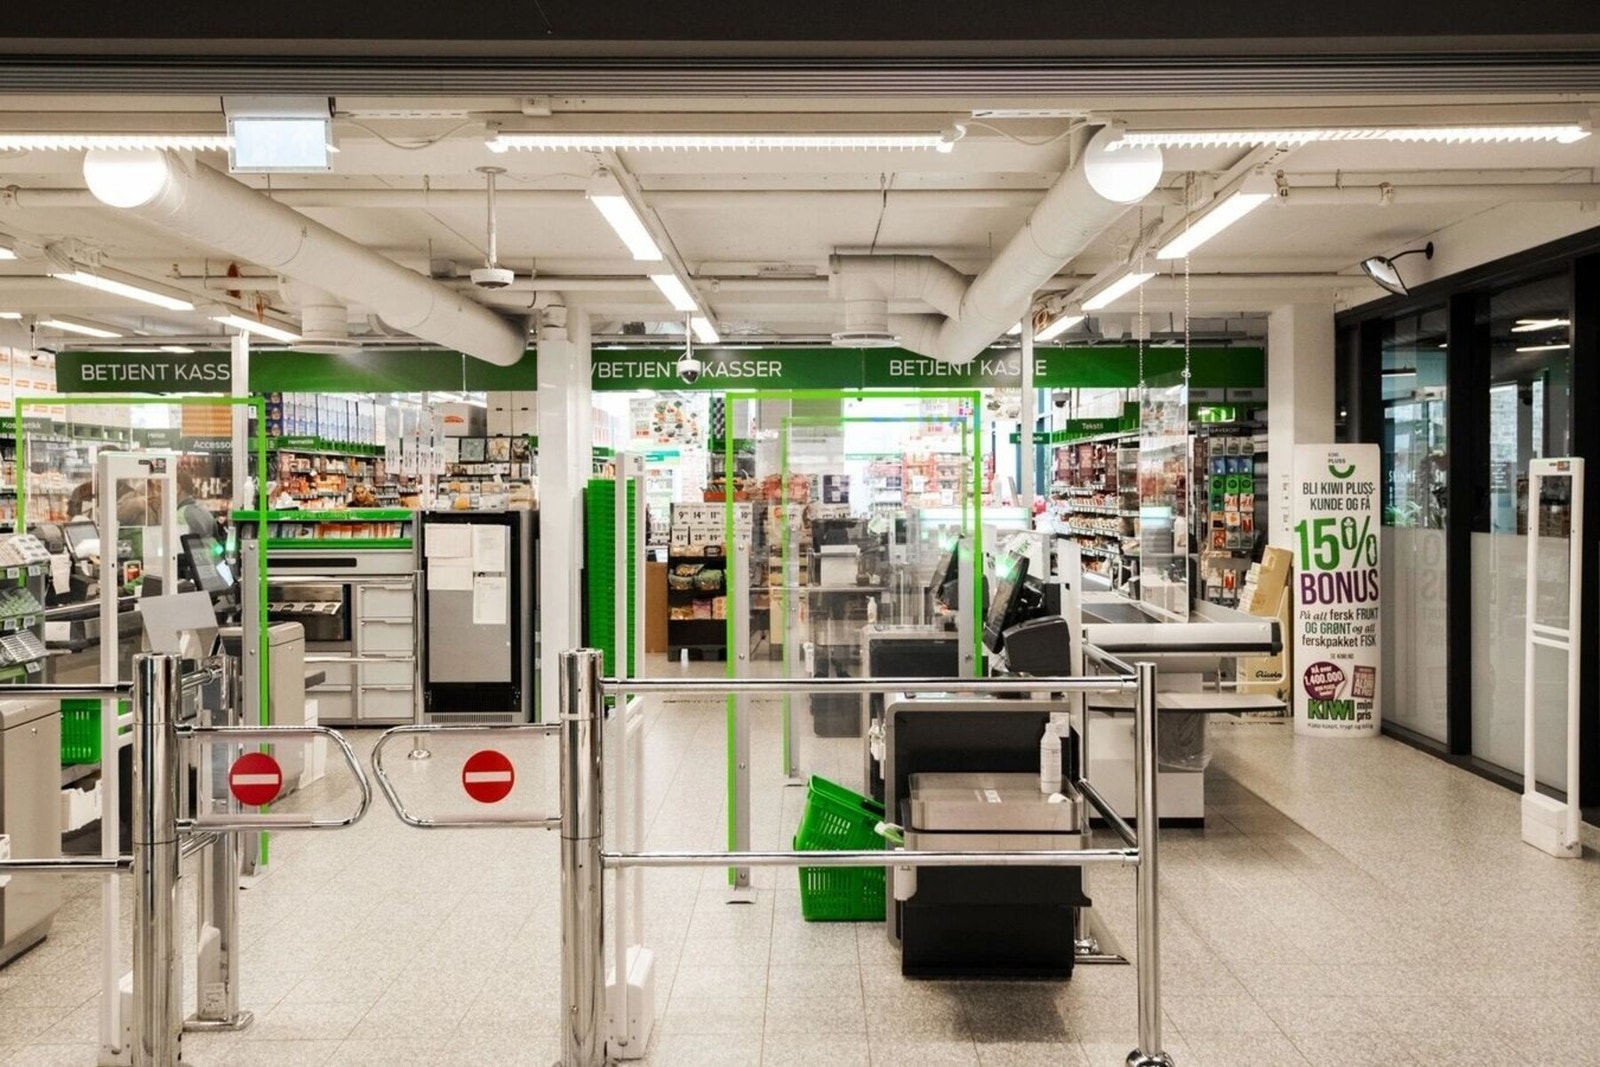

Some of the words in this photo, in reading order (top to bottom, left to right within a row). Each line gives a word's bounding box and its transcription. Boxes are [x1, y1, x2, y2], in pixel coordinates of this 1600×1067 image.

[81, 363, 169, 381] BETJENT
[175, 363, 231, 381] KASS
[701, 360, 782, 378] KASSER
[889, 359, 975, 376] BETJENT
[980, 359, 1047, 376] KASE
[193, 440, 233, 449] Accesso
[1303, 482, 1318, 495] BLI
[1320, 482, 1344, 495] KIWI
[1346, 482, 1376, 495] PLUSS-
[1310, 498, 1343, 511] KUNDE
[1346, 497, 1359, 511] OG
[1361, 494, 1371, 511] FÅ
[1294, 515, 1378, 571] 15%
[1300, 568, 1379, 605] BONUS
[1330, 608, 1354, 621] fersk
[1356, 607, 1379, 620] FRUKT
[1305, 622, 1318, 634] OG
[1320, 621, 1352, 635] GRØNT
[1352, 625, 1363, 634] og
[1302, 634, 1358, 648] ferskpakket
[1360, 634, 1377, 647] FISK
[1307, 698, 1355, 720] KIWI
[1356, 699, 1373, 710] mini
[1356, 710, 1372, 722] pris
